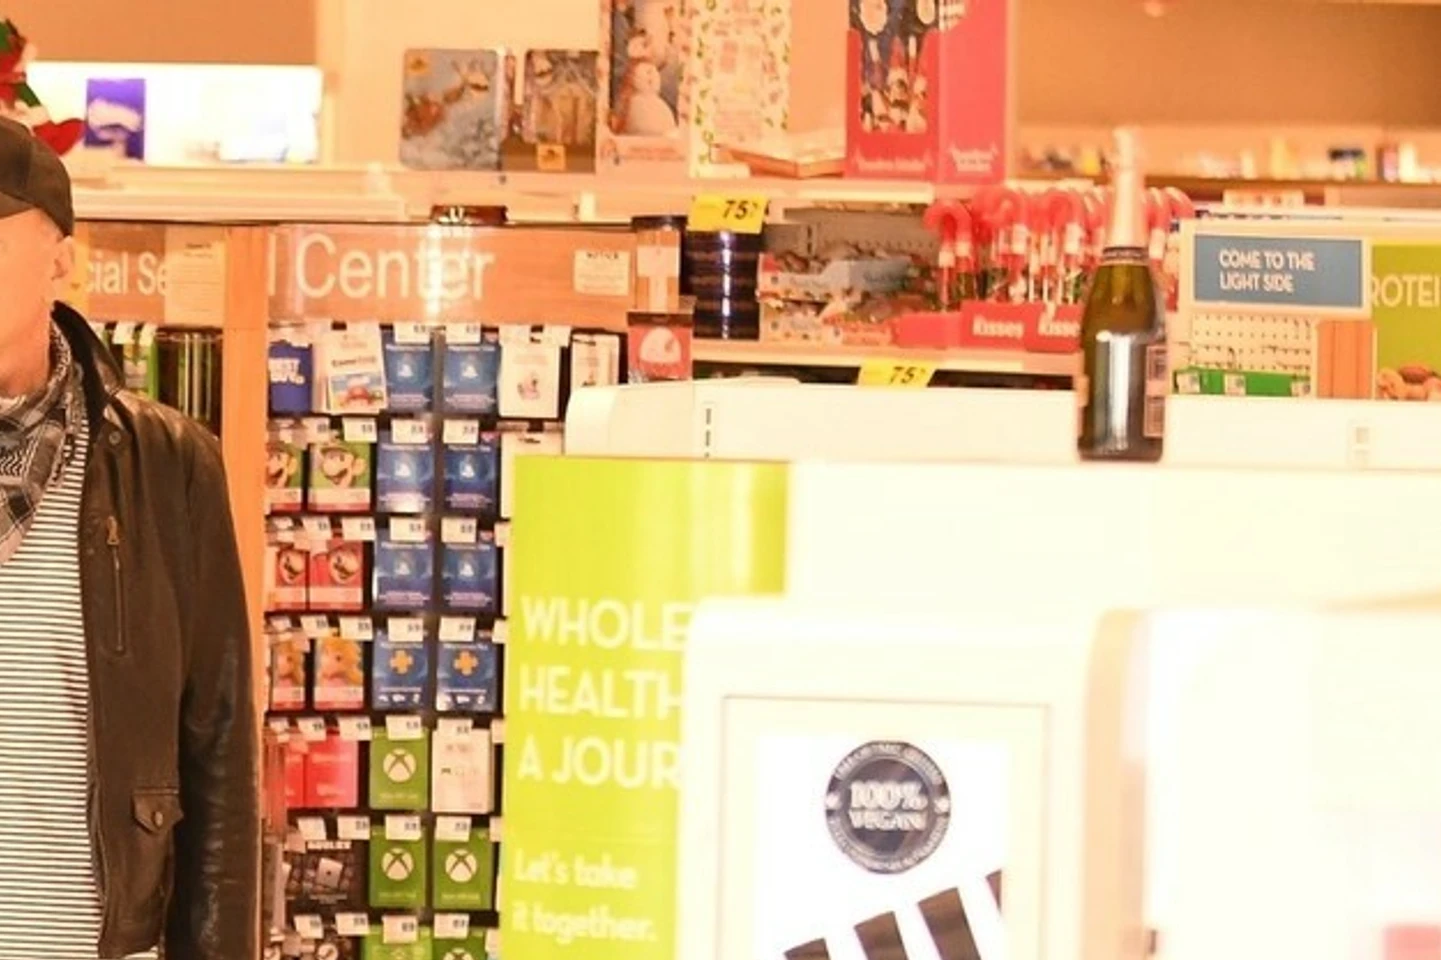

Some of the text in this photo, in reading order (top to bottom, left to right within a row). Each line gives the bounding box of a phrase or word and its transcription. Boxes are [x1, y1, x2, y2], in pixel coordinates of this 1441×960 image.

[295, 232, 496, 300] Center
[1219, 248, 1316, 272] COME TO THE
[1219, 272, 1294, 293] LIGHT SIDE
[519, 594, 693, 651] WHOLE
[517, 733, 680, 790] A JOUR
[849, 779, 929, 811] 100%
[514, 848, 638, 890] Let's take
[512, 899, 659, 945] it together.
